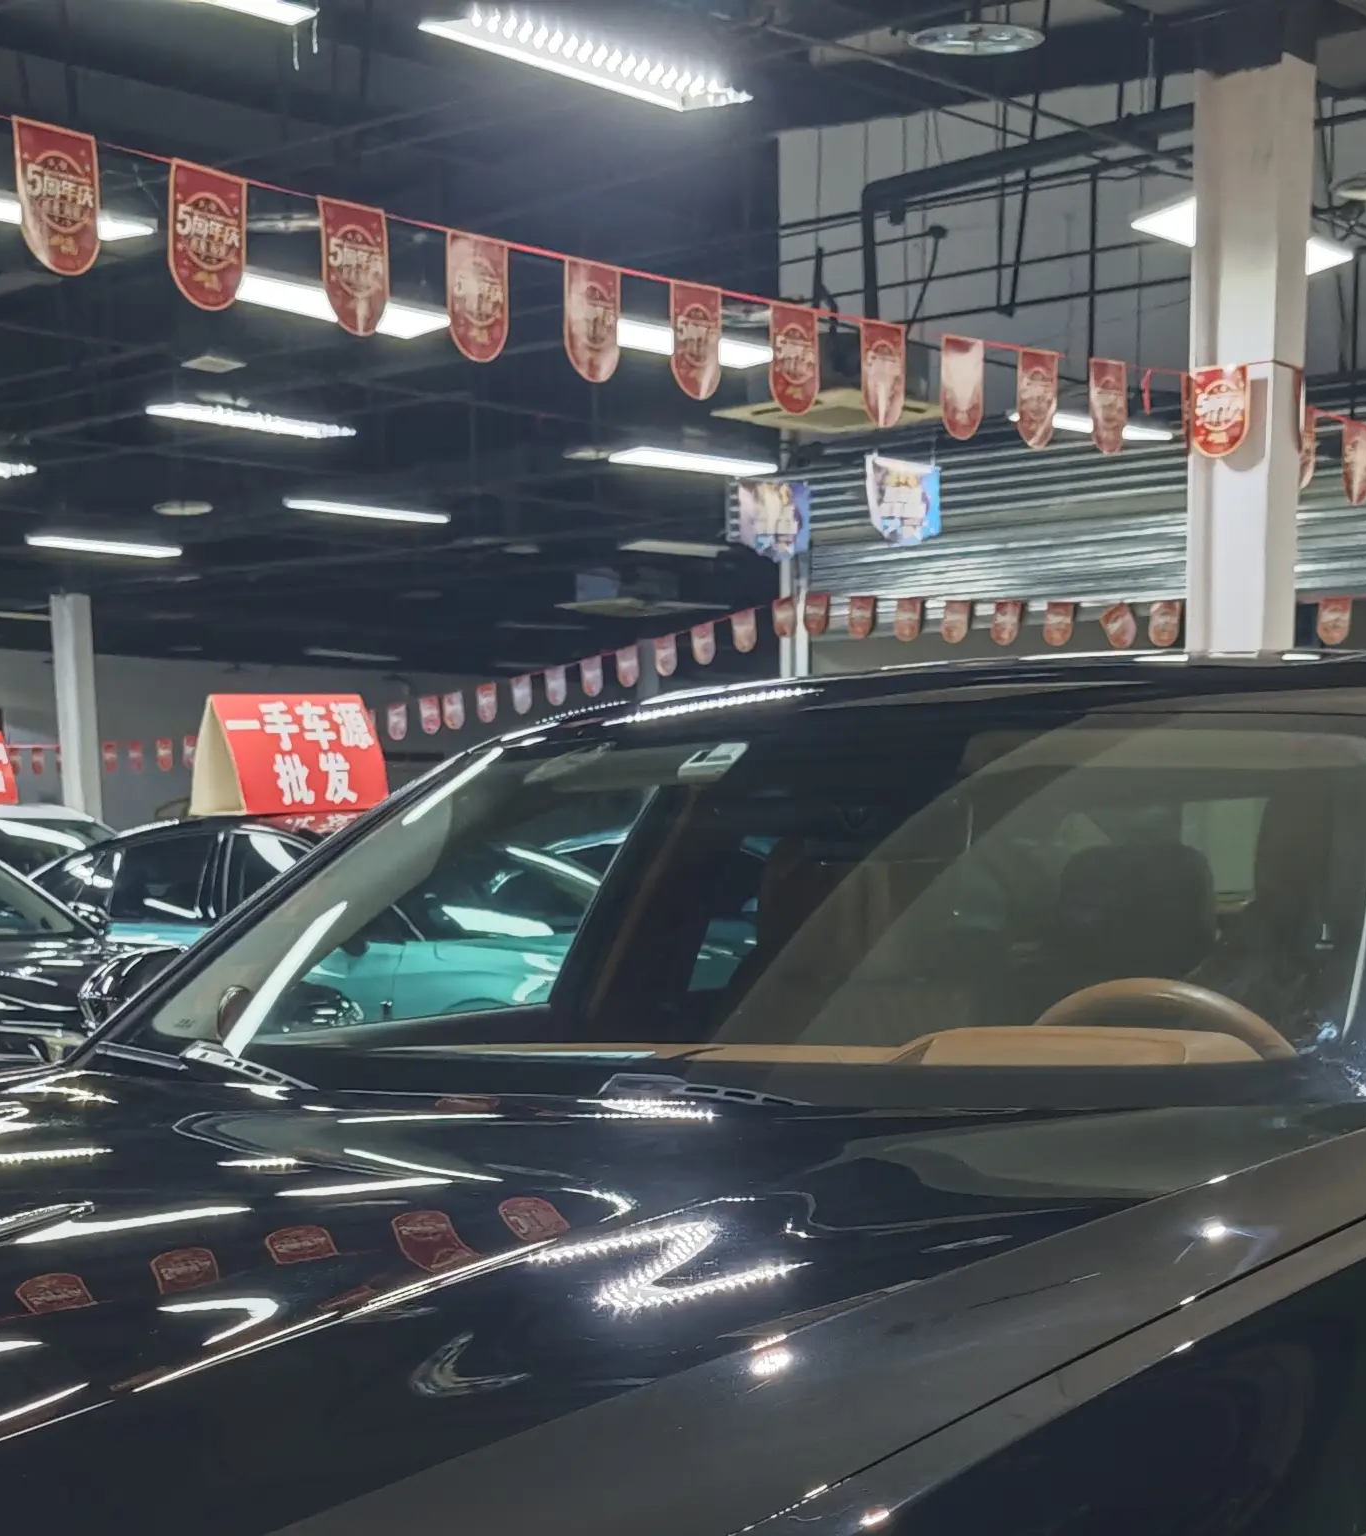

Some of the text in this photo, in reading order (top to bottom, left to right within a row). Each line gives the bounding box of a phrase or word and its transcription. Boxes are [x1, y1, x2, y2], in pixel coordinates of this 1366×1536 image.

[224, 700, 375, 751] 一手车源
[272, 752, 358, 806] 批发
